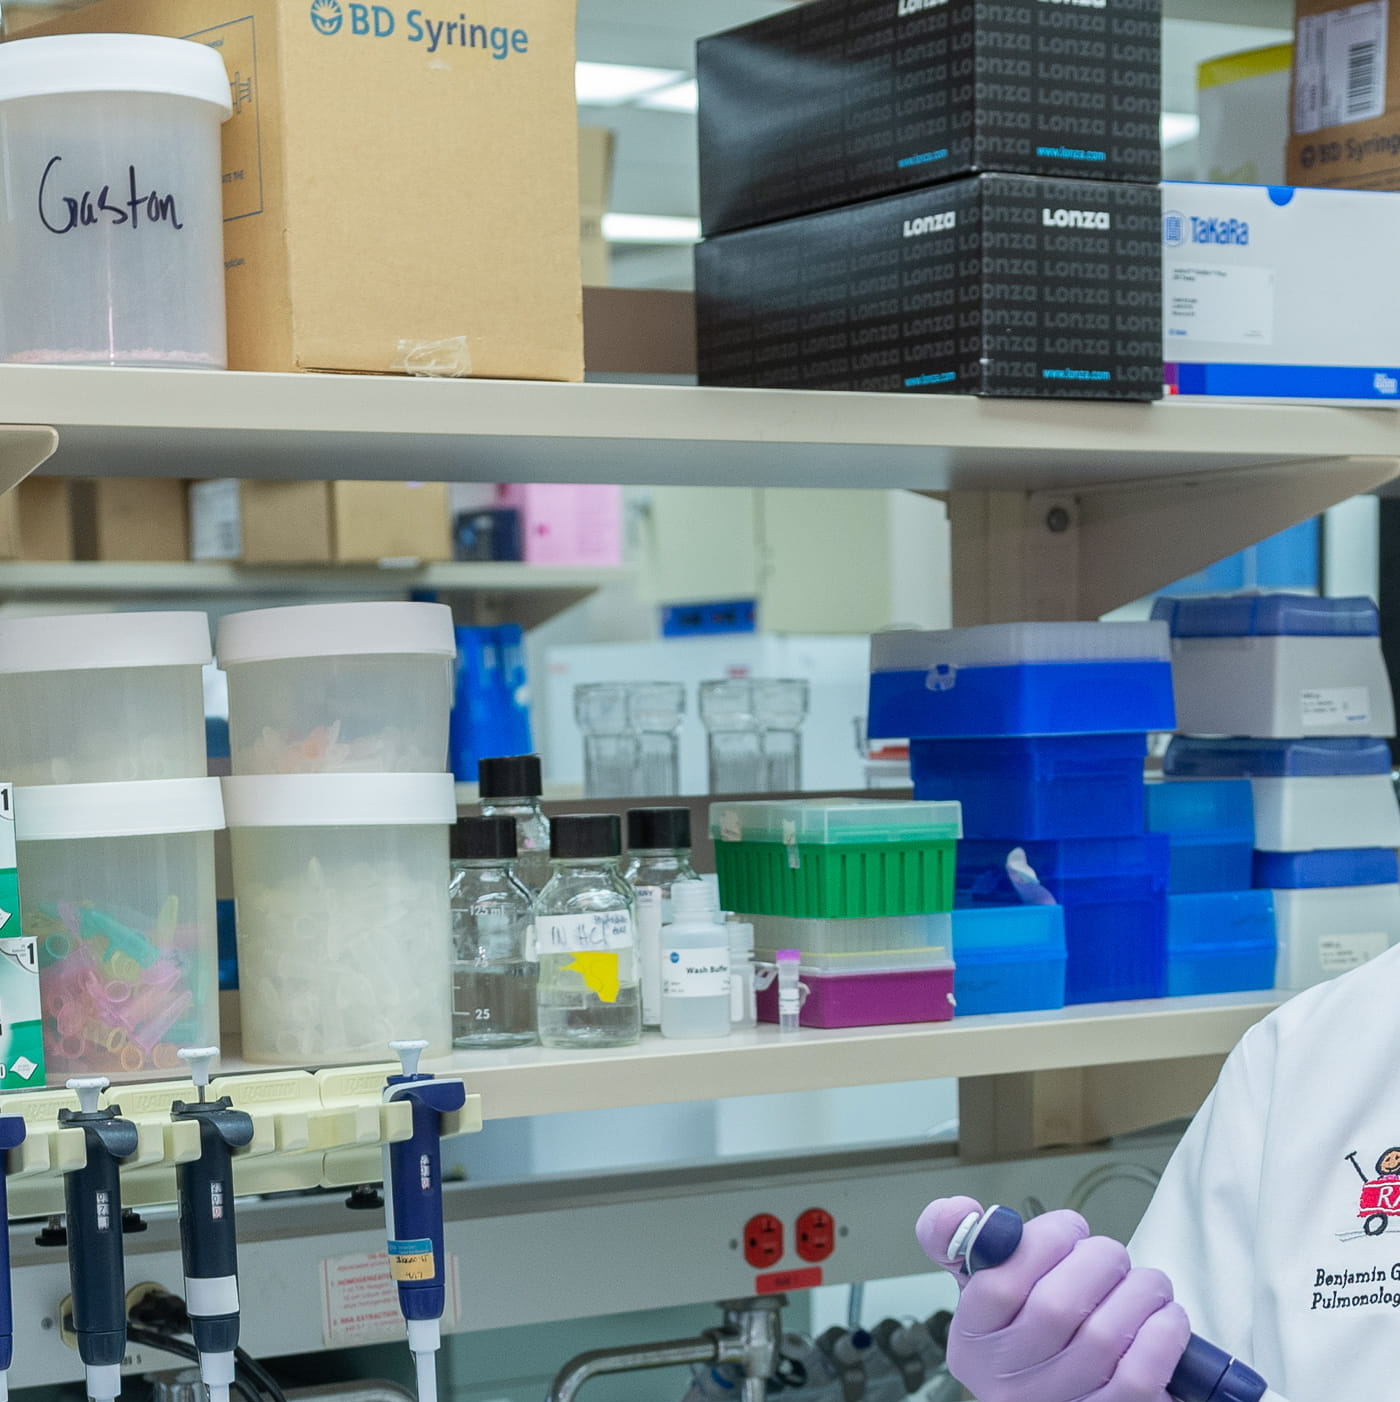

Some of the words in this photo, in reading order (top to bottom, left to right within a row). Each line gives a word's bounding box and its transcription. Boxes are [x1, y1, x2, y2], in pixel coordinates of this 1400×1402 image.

[350, 2, 396, 38] BD
[407, 9, 529, 59] Syringe
[38, 156, 184, 234] Gaston
[903, 211, 956, 238] Lonza
[1042, 208, 1110, 229] Lonza
[1190, 216, 1249, 246] TaKaRa
[0, 788, 9, 811] 1
[469, 906, 489, 915] 125
[27, 943, 34, 965] 1
[475, 1009, 490, 1019] 25
[1314, 1266, 1386, 1289] Benjamin
